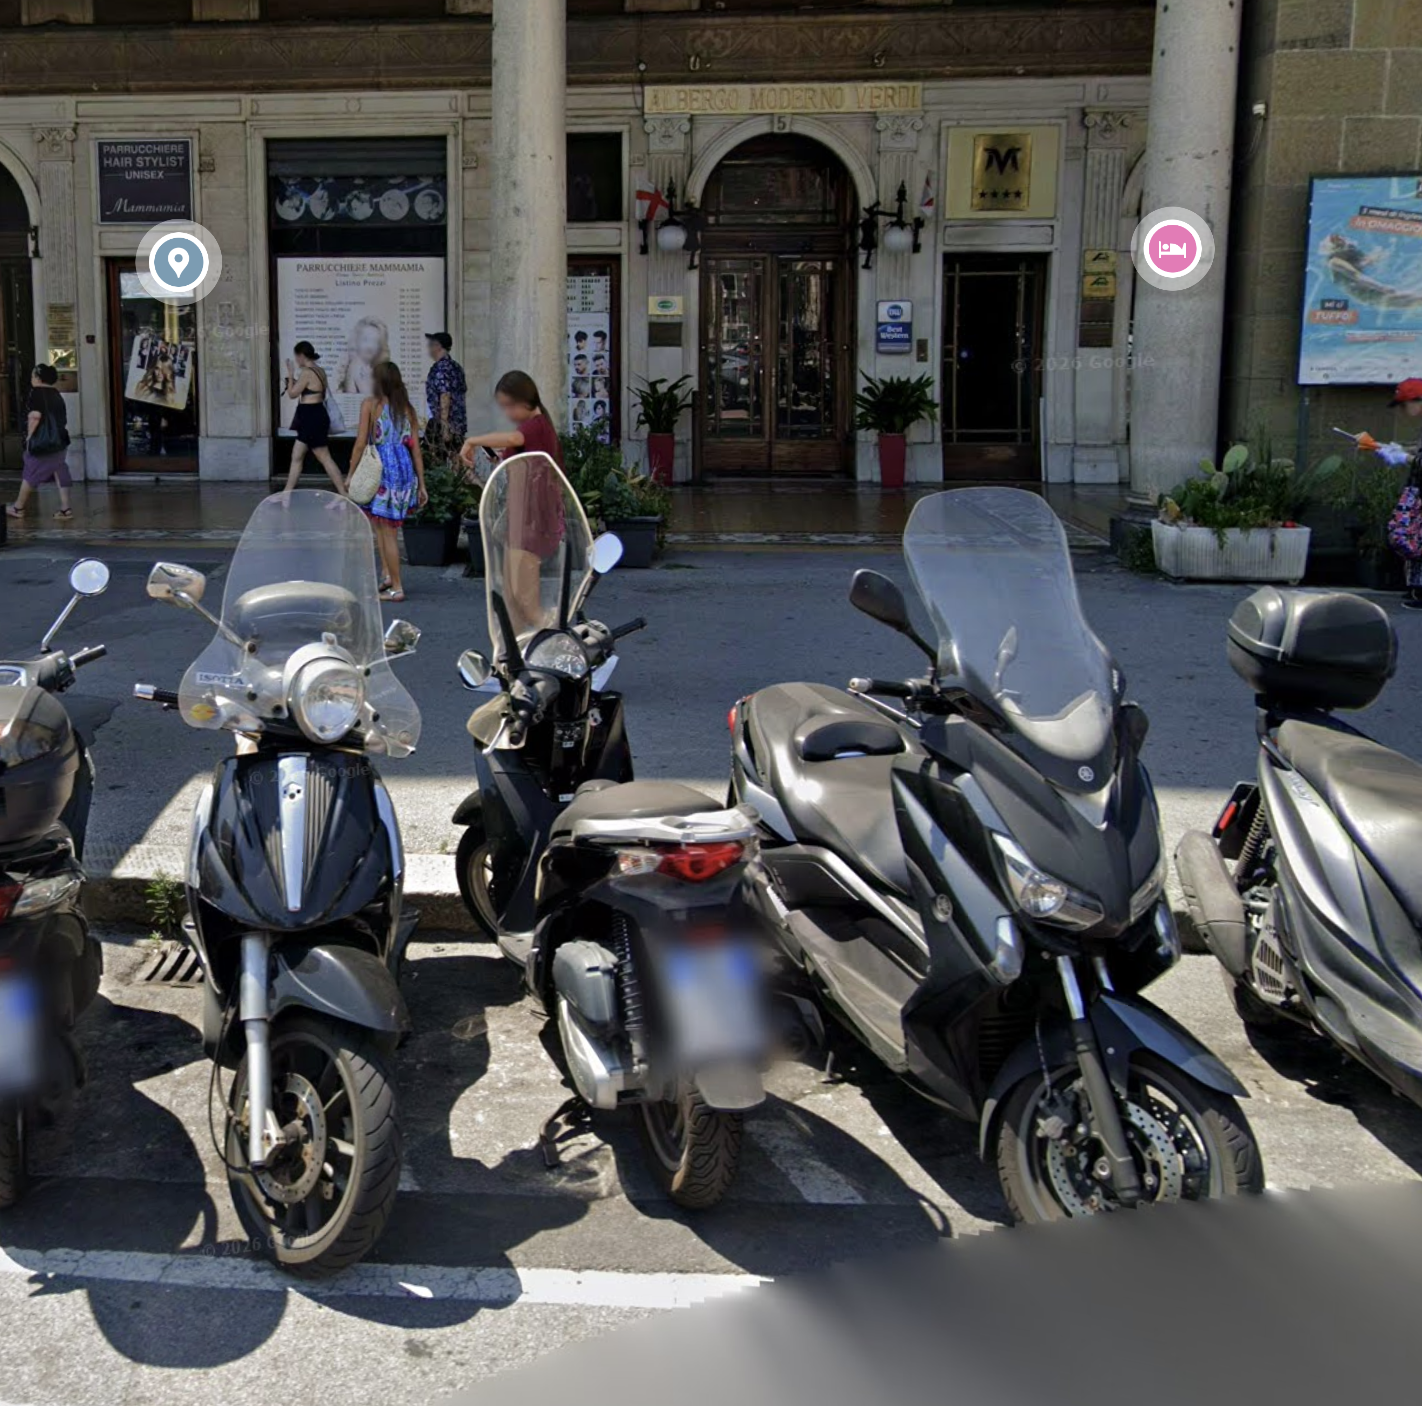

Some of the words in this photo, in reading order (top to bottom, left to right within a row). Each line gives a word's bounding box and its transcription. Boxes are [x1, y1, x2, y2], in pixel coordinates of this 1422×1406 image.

[648, 89, 738, 111] ALBERGO
[749, 88, 844, 110] MODERNO
[857, 86, 919, 108] VERDI
[776, 115, 786, 131] 5
[103, 144, 184, 154] PARRUCCHIERE
[103, 157, 132, 167] HAIR
[136, 156, 184, 167] STYLIST
[125, 170, 164, 180] UNISEX
[105, 198, 185, 215] Mammamia
[296, 263, 366, 272] PARRUCCHIERE
[369, 263, 424, 272] MAMMAMIA
[199, 674, 244, 685] ISOTTA
